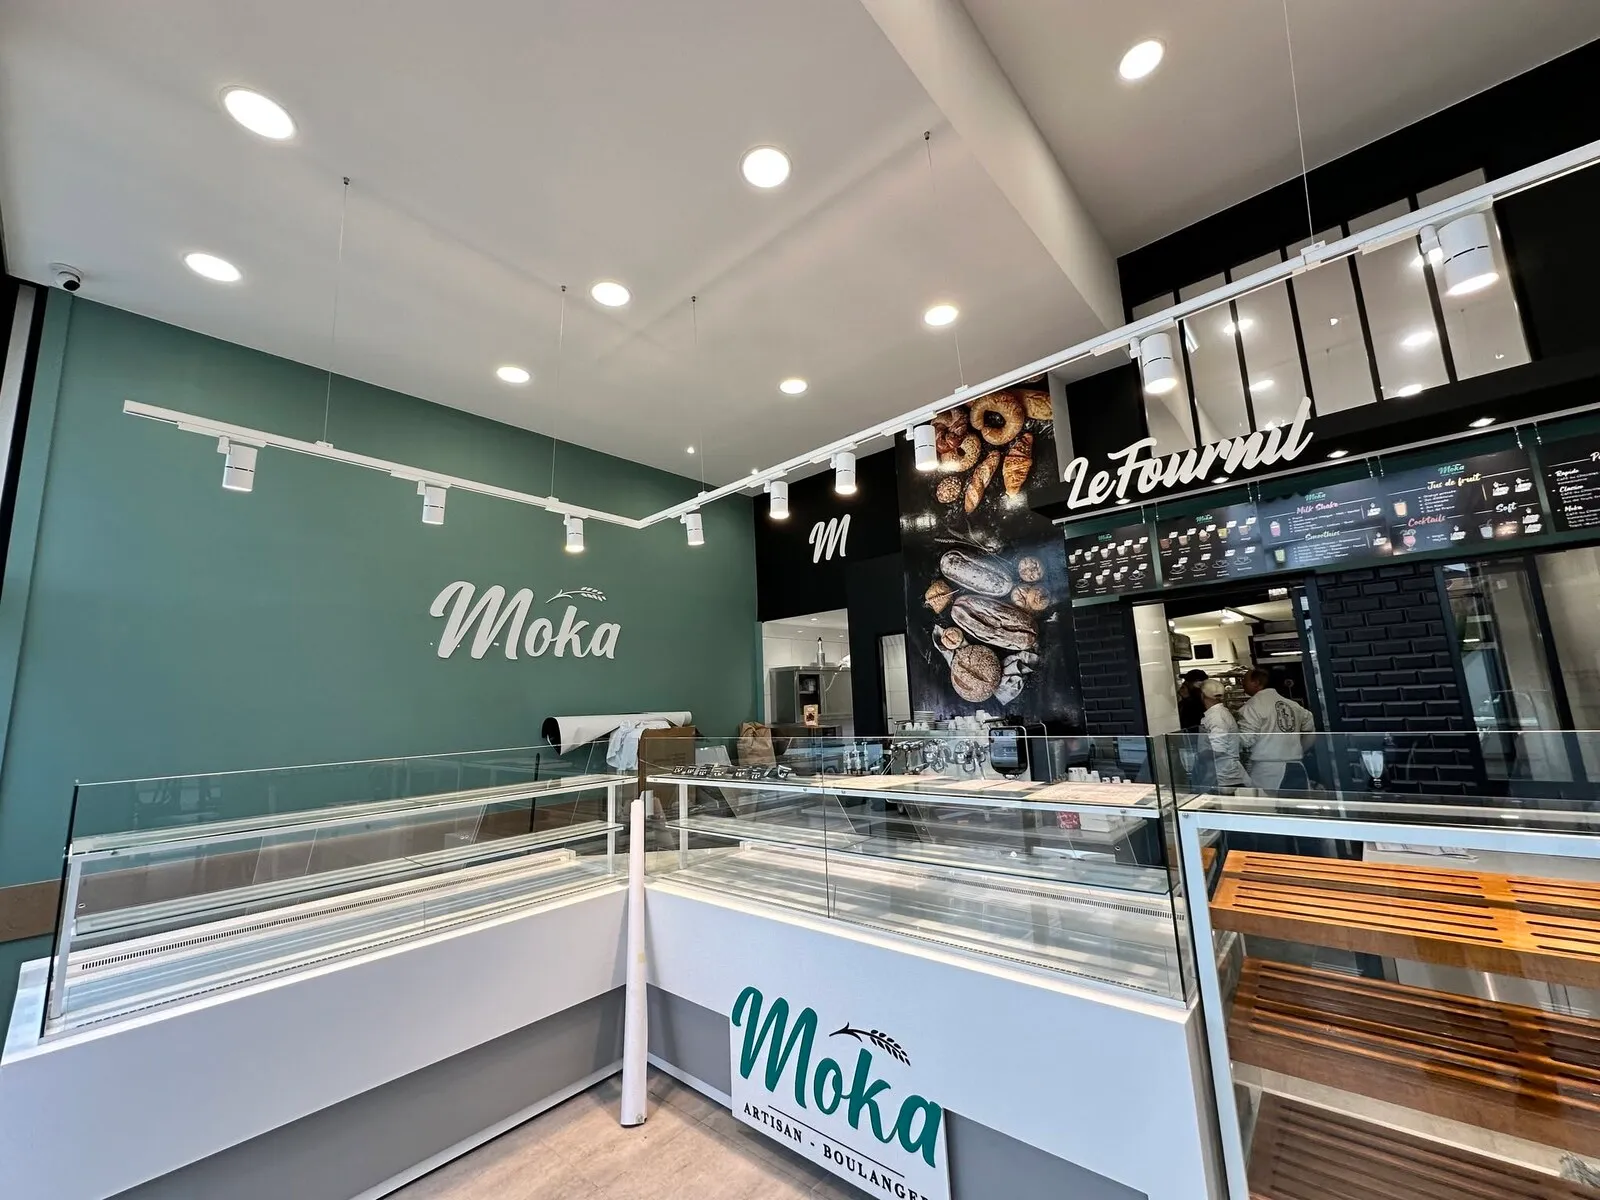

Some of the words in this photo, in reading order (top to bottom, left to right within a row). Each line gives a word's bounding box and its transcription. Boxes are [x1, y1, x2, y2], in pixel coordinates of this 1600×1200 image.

[1427, 480, 1443, 491] Jus
[1445, 478, 1457, 487] de
[1457, 472, 1483, 487] fruit
[1296, 505, 1314, 515] Milk
[1407, 513, 1446, 528] Cocktails
[1495, 501, 1518, 514] Soft
[808, 513, 851, 564] M
[429, 580, 622, 660] Moka
[731, 985, 943, 1168] Moka
[743, 1102, 803, 1144] ARTISAN
[823, 1143, 930, 1200] BOULANGE
